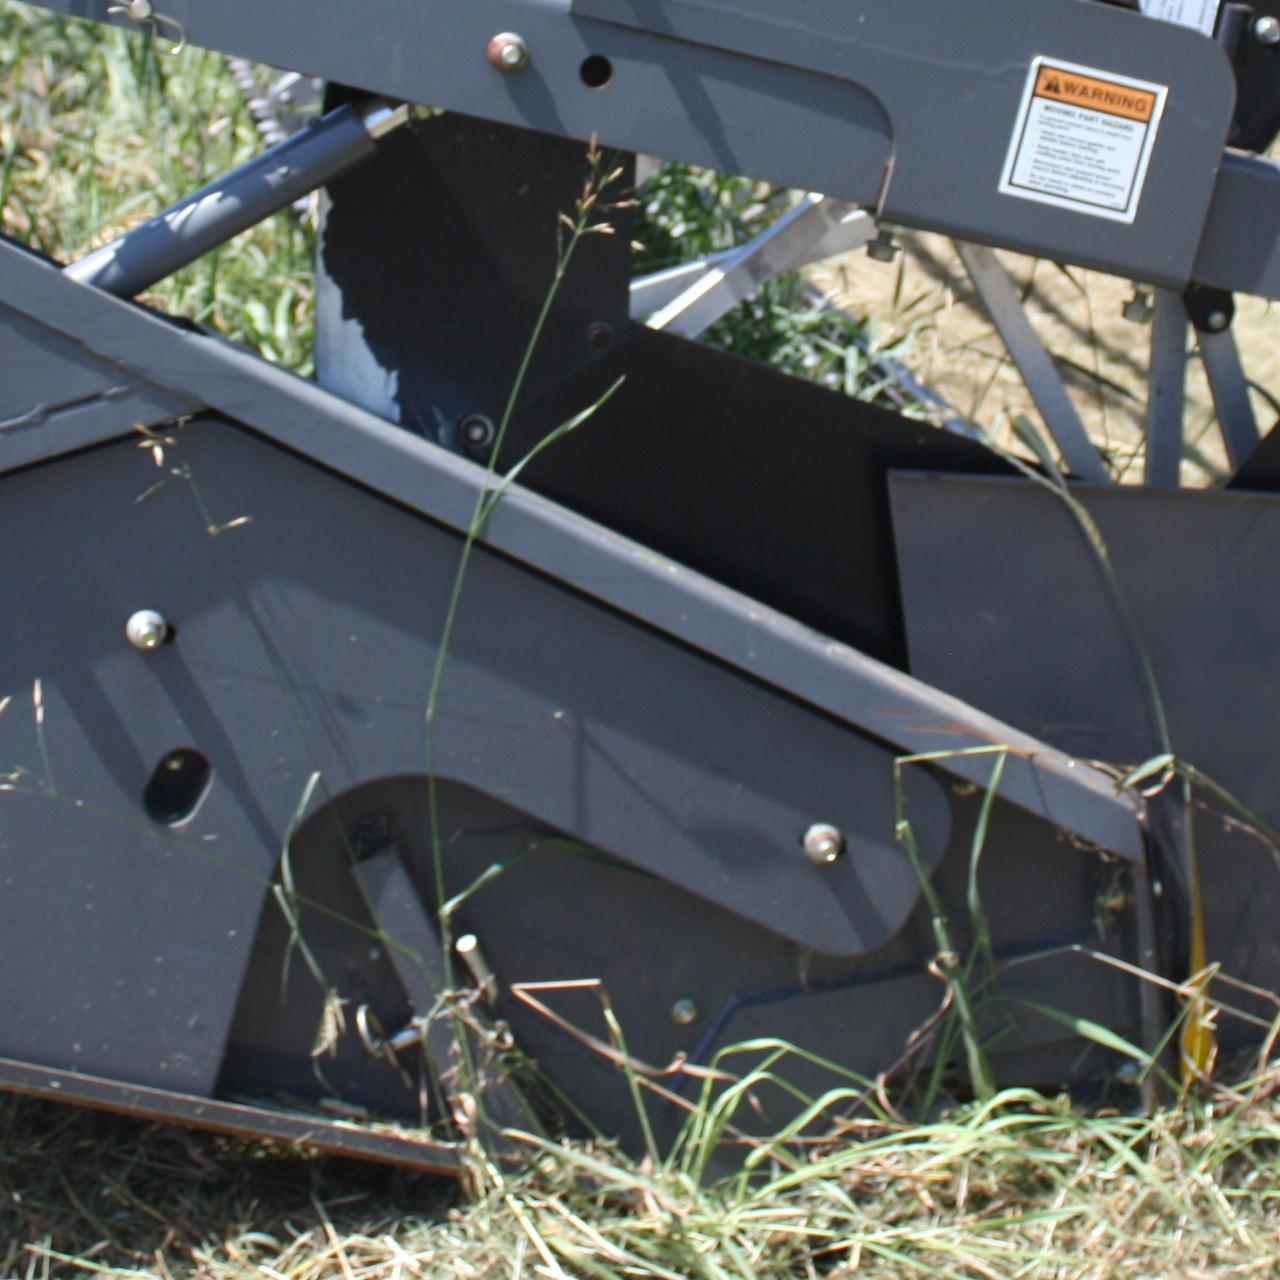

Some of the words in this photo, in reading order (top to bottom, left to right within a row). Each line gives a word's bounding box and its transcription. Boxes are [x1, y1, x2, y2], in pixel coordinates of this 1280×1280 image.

[1065, 81, 1147, 112] WARNING
[1044, 105, 1075, 117] MOVING
[1078, 113, 1098, 123] PART
[1102, 118, 1135, 131] HAZARD
